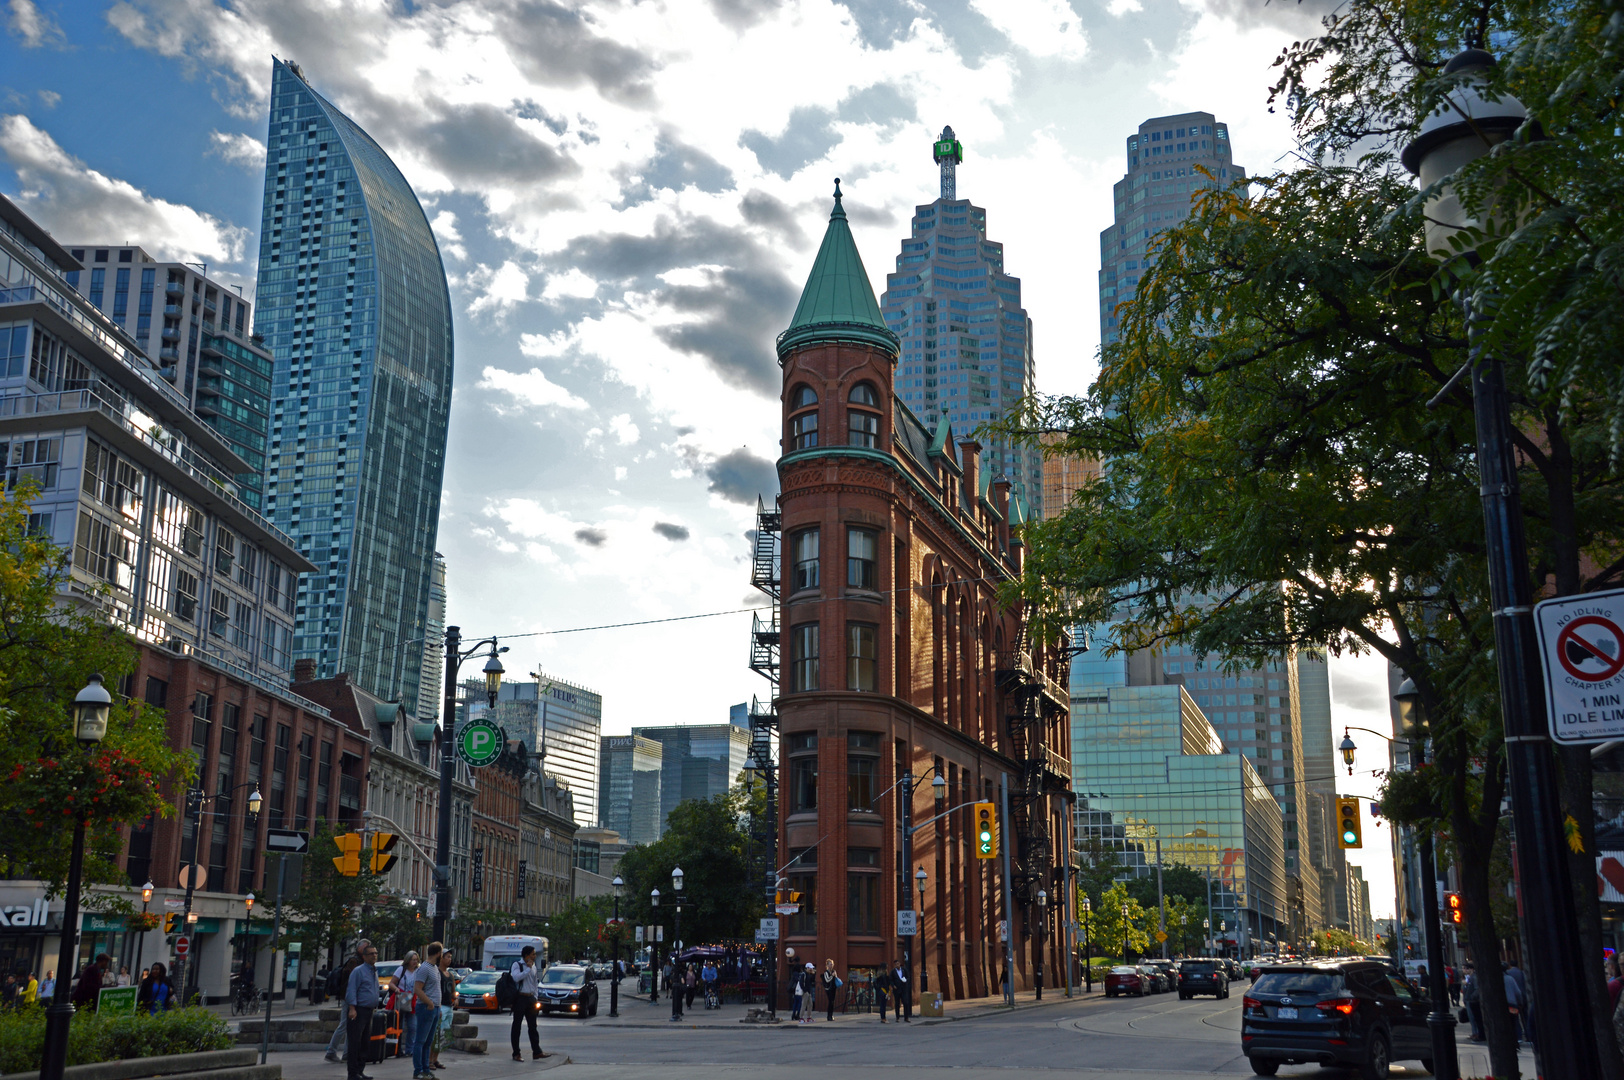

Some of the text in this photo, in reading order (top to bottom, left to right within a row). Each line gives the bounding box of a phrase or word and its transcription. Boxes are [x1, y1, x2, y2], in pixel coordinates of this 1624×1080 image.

[938, 142, 952, 152] TD
[1556, 607, 1612, 628] NO IDLING
[1564, 676, 1613, 690] CHAPTER
[552, 687, 577, 704] TELUS
[1580, 694, 1620, 708] 1 MIN
[1562, 711, 1597, 725] IDLE
[459, 720, 501, 742] MUNICIPAL
[471, 731, 490, 750] P
[609, 737, 632, 749] pwc
[459, 746, 501, 766] PARKING
[475, 851, 483, 890] WINNERS
[519, 863, 527, 897] WINNERS
